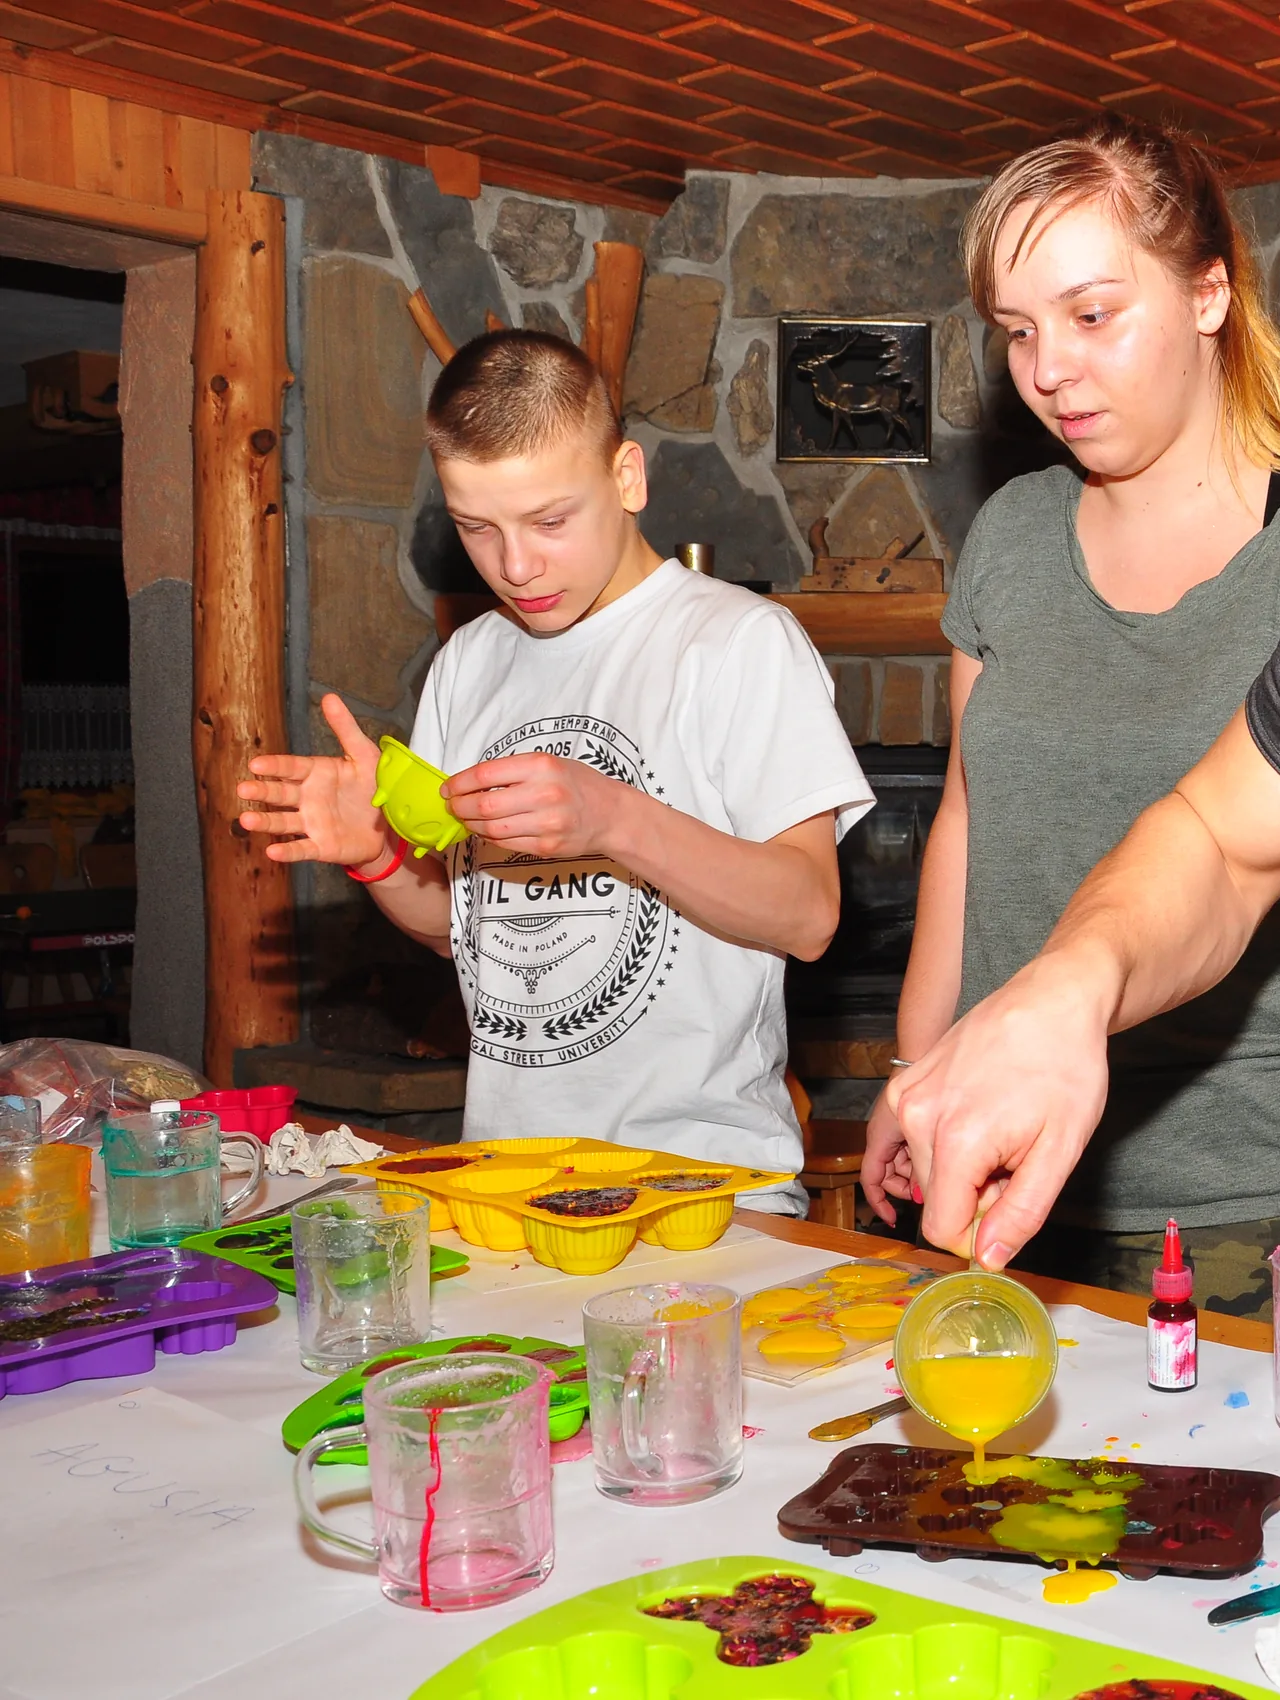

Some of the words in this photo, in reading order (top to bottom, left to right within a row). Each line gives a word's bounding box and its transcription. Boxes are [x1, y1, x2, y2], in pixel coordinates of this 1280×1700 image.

[485, 722, 545, 761] ORIGINAL
[525, 871, 615, 901] GANG
[492, 933, 515, 951] MADE
[518, 944, 529, 953] IN
[535, 931, 568, 952] POLAND
[503, 1050, 545, 1065] STREET
[557, 1016, 629, 1062] UNIVERSITY
